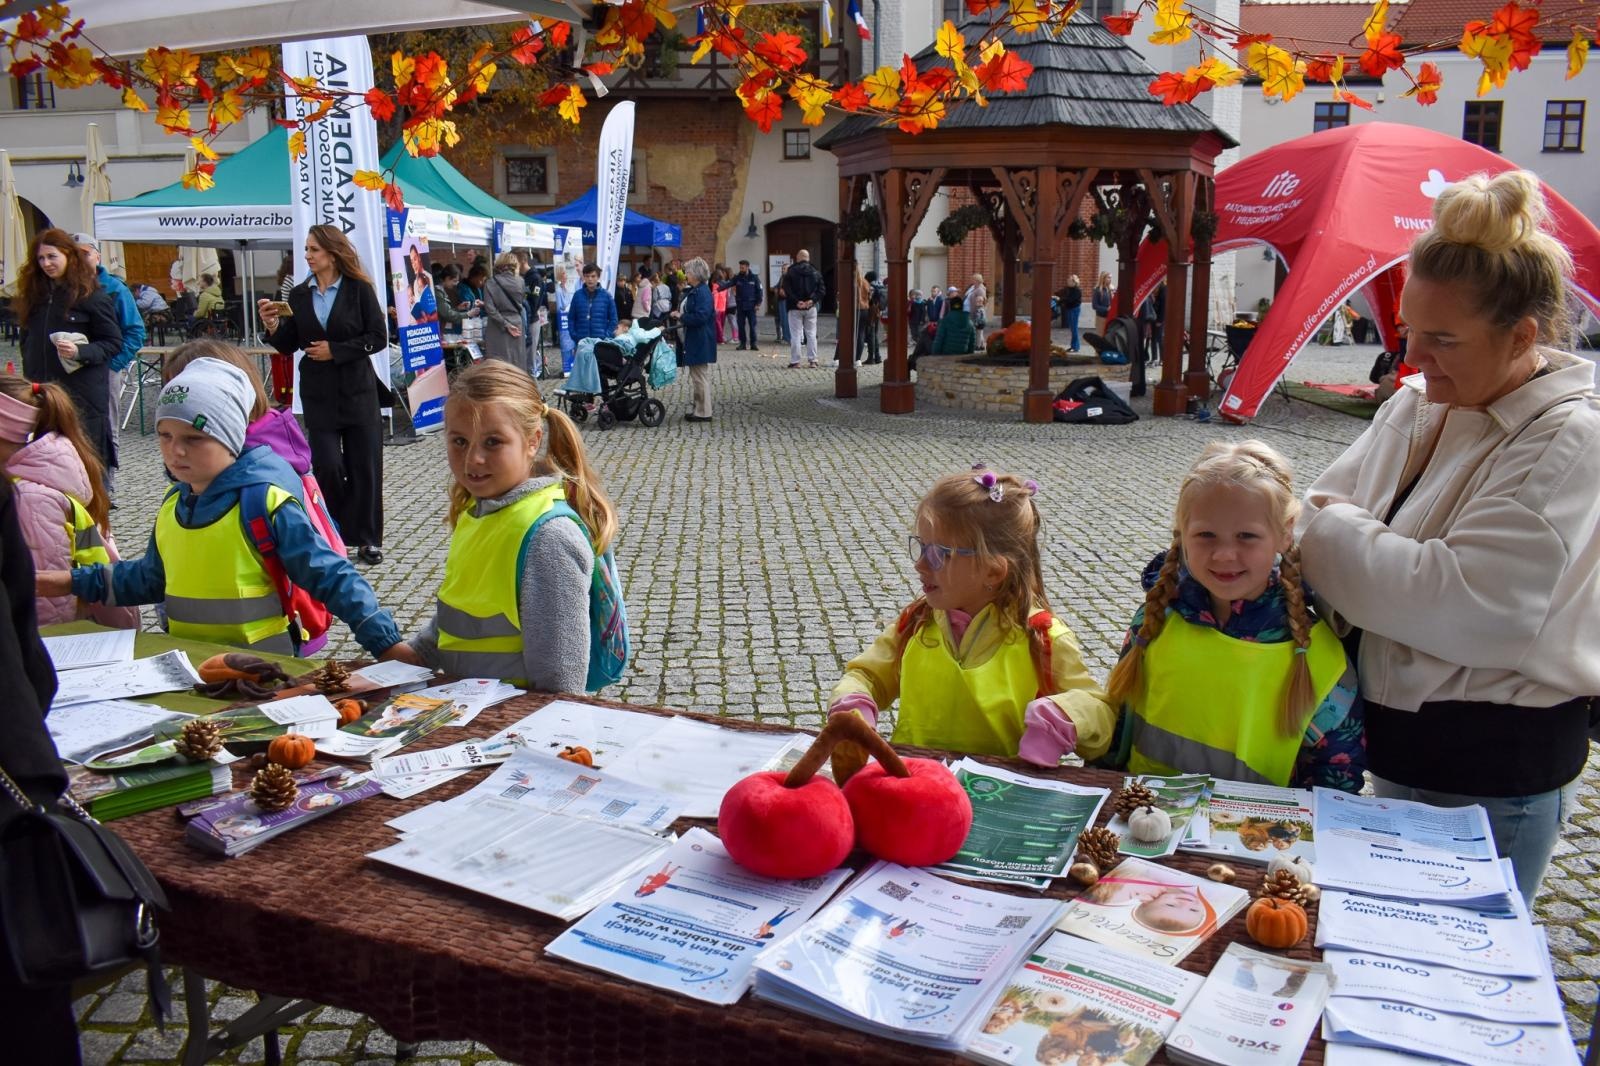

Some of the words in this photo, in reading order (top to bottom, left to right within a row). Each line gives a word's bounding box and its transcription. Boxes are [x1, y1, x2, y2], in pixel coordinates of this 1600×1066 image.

[1261, 170, 1301, 198] life
[158, 213, 293, 229] www.powiatracibo
[1393, 215, 1433, 230] PUNKT
[1282, 254, 1377, 361] www.life-ratownictwo.pl
[1342, 899, 1437, 919] oddechowy
[617, 913, 654, 930] ciąży
[1441, 915, 1488, 929] wirus
[603, 920, 659, 940] infekcji
[655, 925, 670, 934] w
[1454, 924, 1489, 936] RSV
[660, 935, 687, 949] bez
[672, 929, 719, 947] kobiet
[690, 943, 739, 962] Jesień
[722, 942, 746, 953] dla
[874, 967, 892, 976] od
[1348, 959, 1431, 977] COVID-19
[893, 972, 911, 983] się
[1042, 975, 1095, 994] CHOROBA
[913, 978, 962, 993] zaczyna
[913, 987, 957, 1000] Złota
[1147, 1011, 1162, 1020] TO
[1381, 1003, 1437, 1022] Grypa
